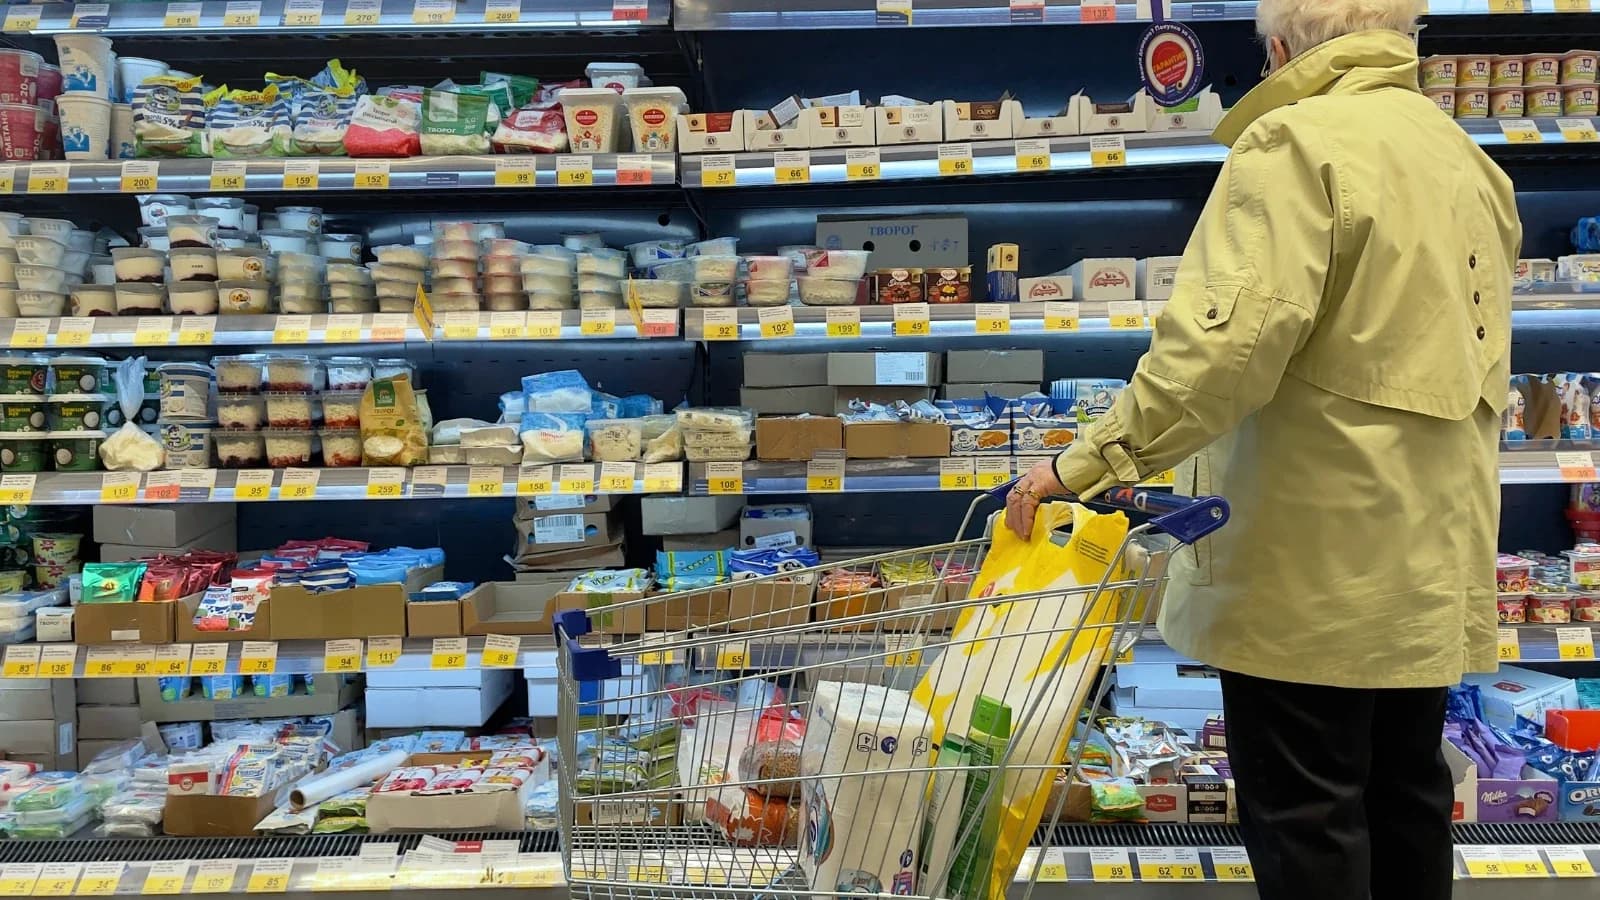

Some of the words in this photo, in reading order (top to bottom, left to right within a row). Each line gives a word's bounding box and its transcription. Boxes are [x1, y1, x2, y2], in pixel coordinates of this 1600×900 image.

[1153, 50, 1186, 72] ГАРАНТИЯ
[427, 126, 456, 134] ТВОРОГ
[1, 111, 13, 158] СМЕТАНА
[870, 224, 918, 236] ТВОРОГ
[1126, 317, 1136, 325] 56
[772, 324, 786, 332] 102
[838, 325, 852, 333] 199
[957, 476, 966, 484] 50
[993, 475, 1003, 483] 50
[1481, 790, 1508, 802] Milka
